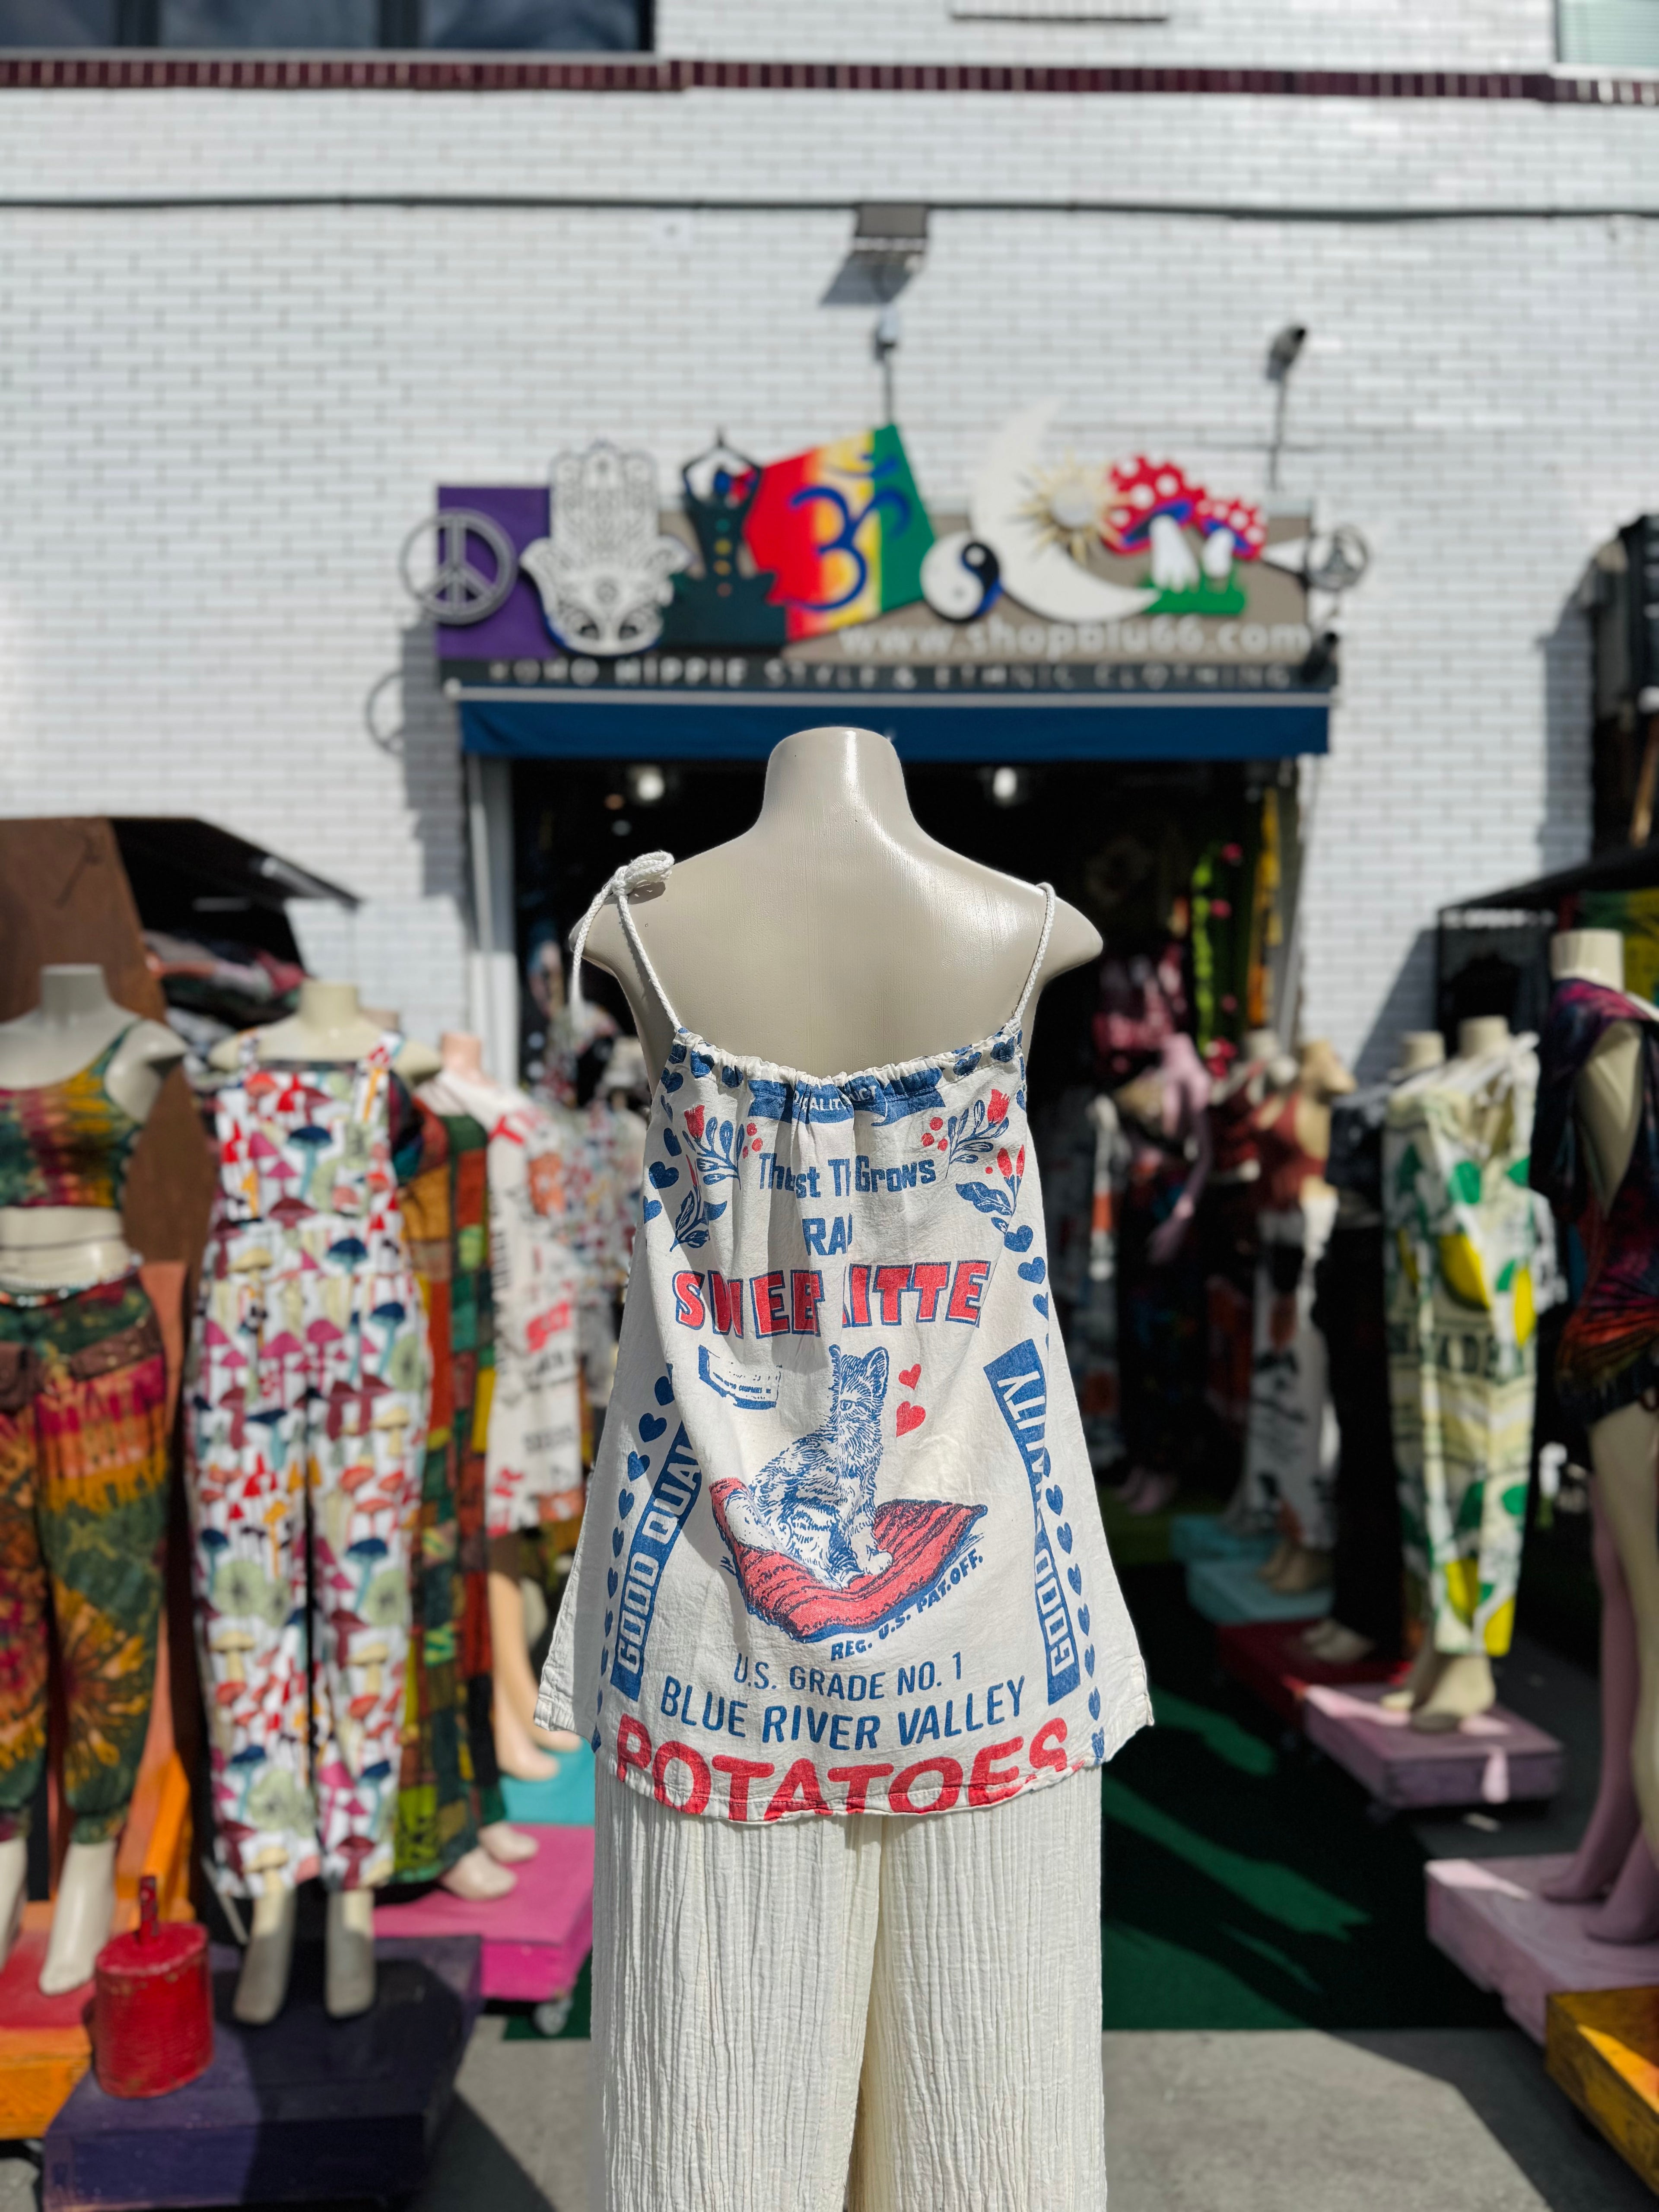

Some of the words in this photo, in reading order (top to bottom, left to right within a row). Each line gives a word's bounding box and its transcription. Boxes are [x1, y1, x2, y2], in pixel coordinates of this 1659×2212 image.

[616, 658, 747, 686] HIPPIE
[766, 659, 876, 688] STYLE
[935, 664, 1075, 690] ETHNIC
[1095, 664, 1291, 690] CLOTHING
[855, 1155, 936, 1192] Grows
[618, 1552, 659, 1674] GOOD
[831, 1639, 872, 1661] REG.
[878, 1614, 911, 1640] U.S.
[734, 1653, 776, 1690] U.S.
[789, 1665, 886, 1702] GRADE
[897, 1660, 942, 1696] NO.
[952, 1651, 962, 1681] 1
[660, 1675, 748, 1738] BLUE
[762, 1705, 881, 1751] RIVER
[898, 1675, 1025, 1747] VALLEY
[617, 1713, 1070, 1822] POTATOES
